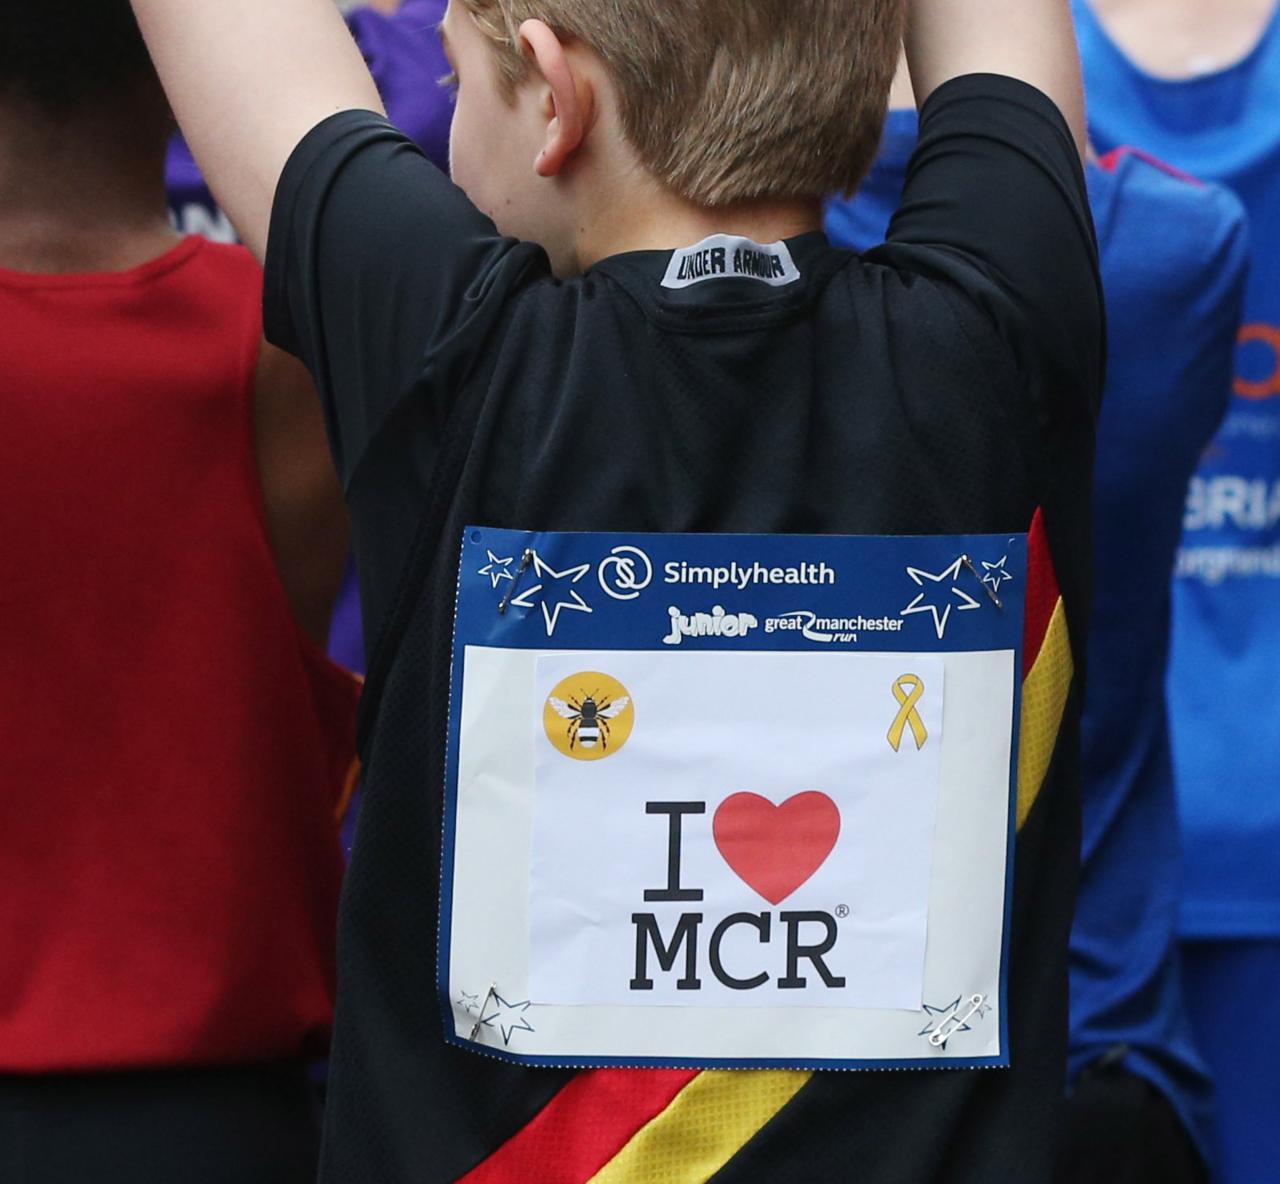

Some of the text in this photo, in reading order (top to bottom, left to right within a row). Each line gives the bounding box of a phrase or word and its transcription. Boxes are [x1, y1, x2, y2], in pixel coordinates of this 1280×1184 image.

[677, 247, 785, 280] UNDER ARMOUR
[663, 561, 835, 589] Simplyhealth
[663, 605, 904, 645] junior great manchester
[833, 633, 858, 643] run
[643, 801, 706, 902] I
